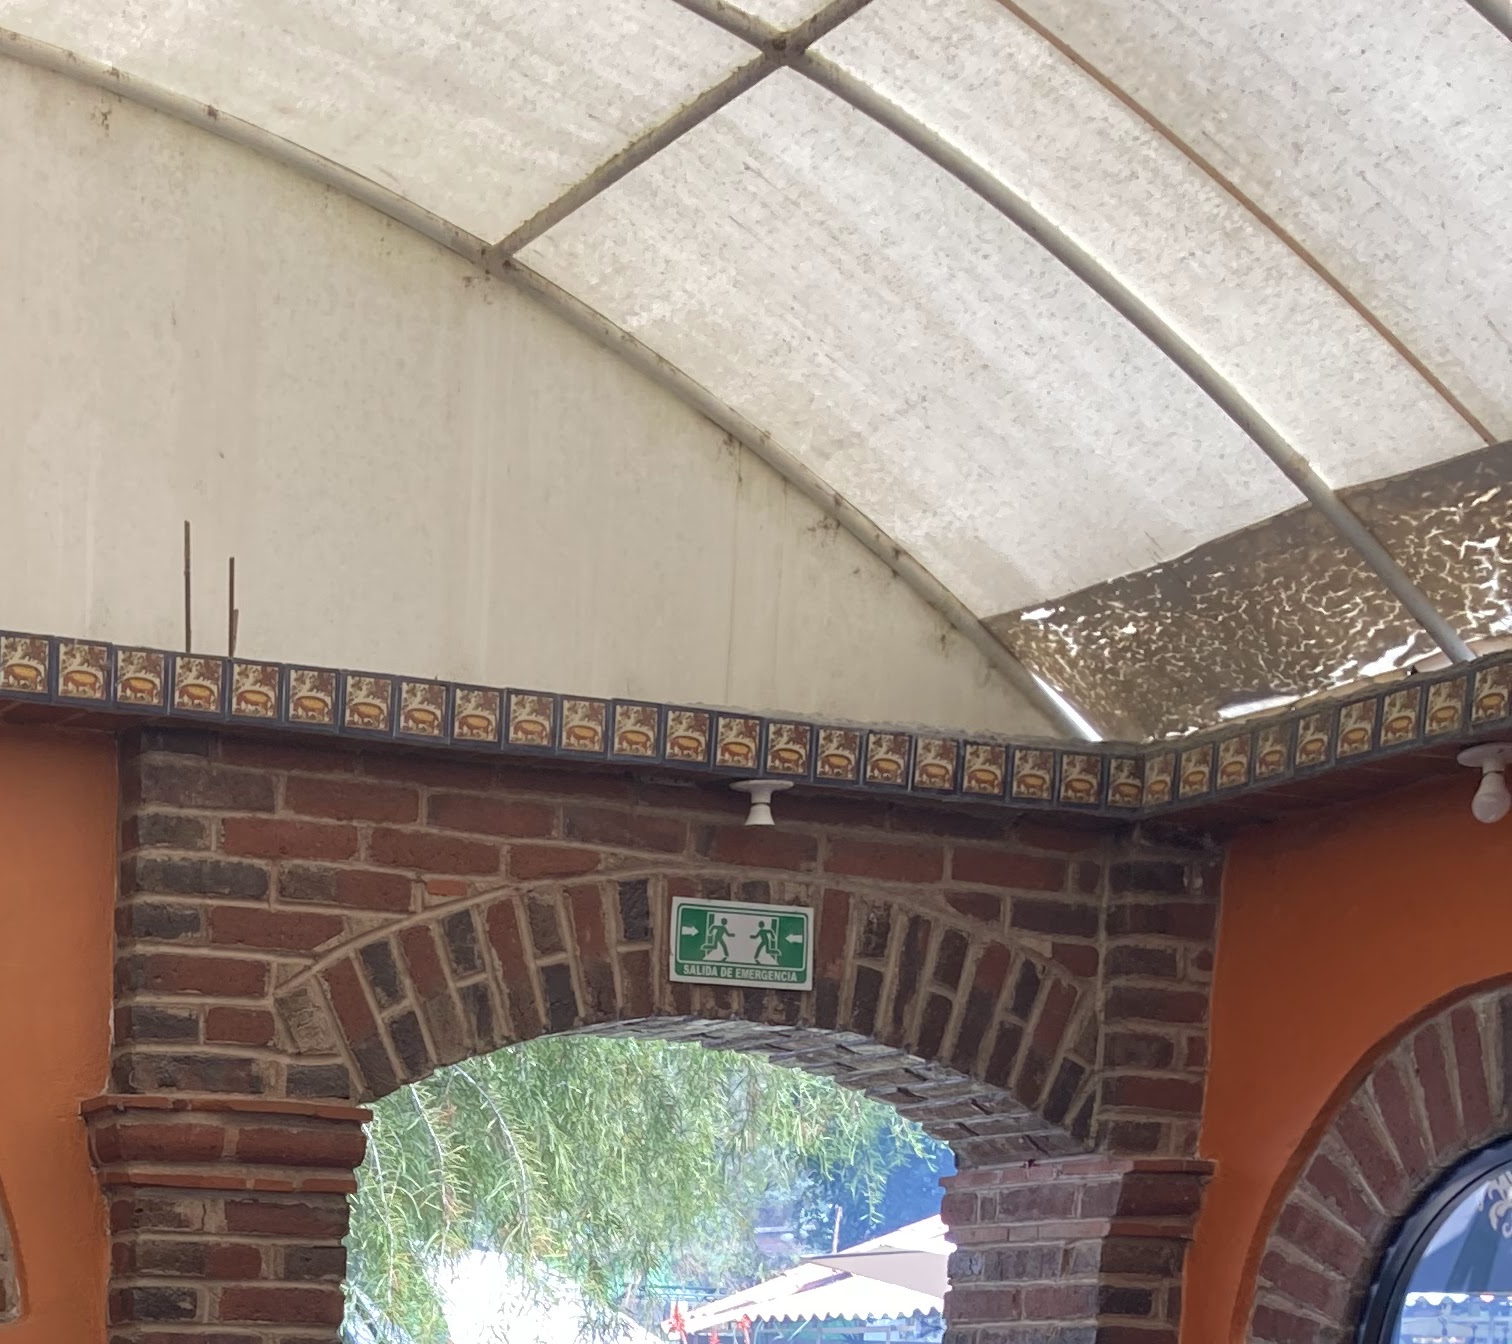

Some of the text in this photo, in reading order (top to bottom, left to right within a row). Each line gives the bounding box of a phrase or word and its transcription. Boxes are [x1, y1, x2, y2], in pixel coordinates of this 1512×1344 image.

[683, 964, 798, 982] SALIDA DE EMERGENCIA
